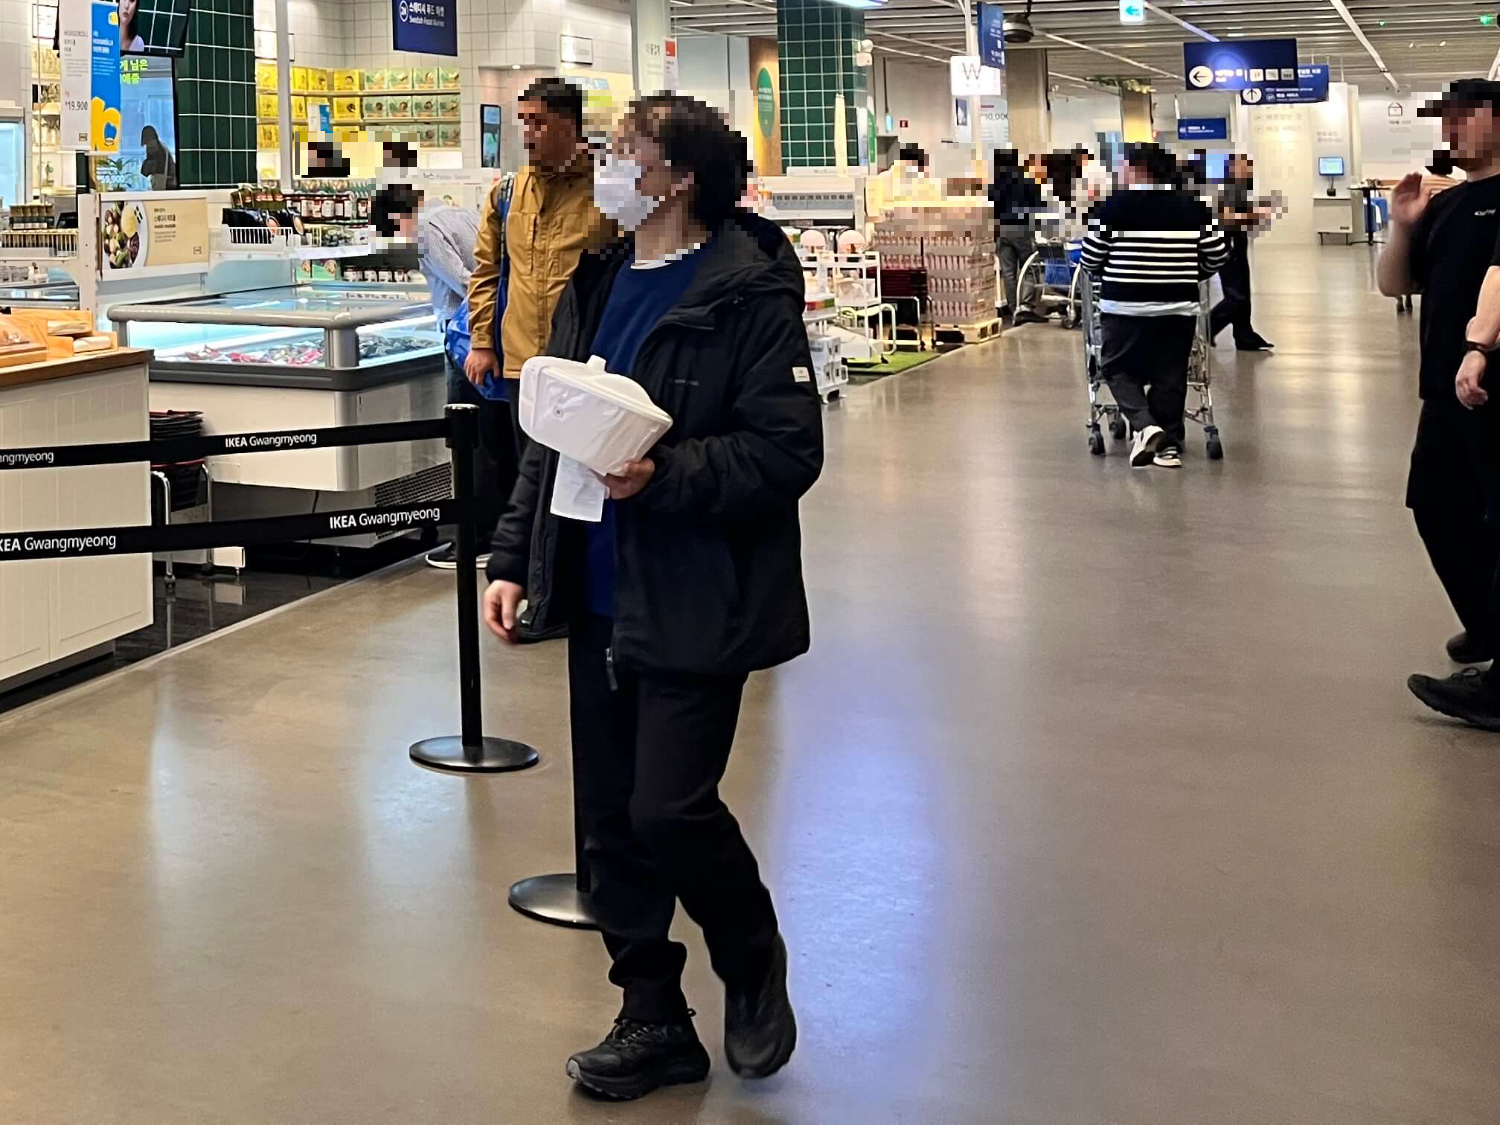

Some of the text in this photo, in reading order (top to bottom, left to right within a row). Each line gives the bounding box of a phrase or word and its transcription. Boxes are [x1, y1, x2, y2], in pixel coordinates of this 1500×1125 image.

[225, 434, 317, 448] IKEA Gwangmyeong
[329, 507, 440, 529] IKEA Gwangmyeong
[24, 535, 117, 552] Gwangmyeong
